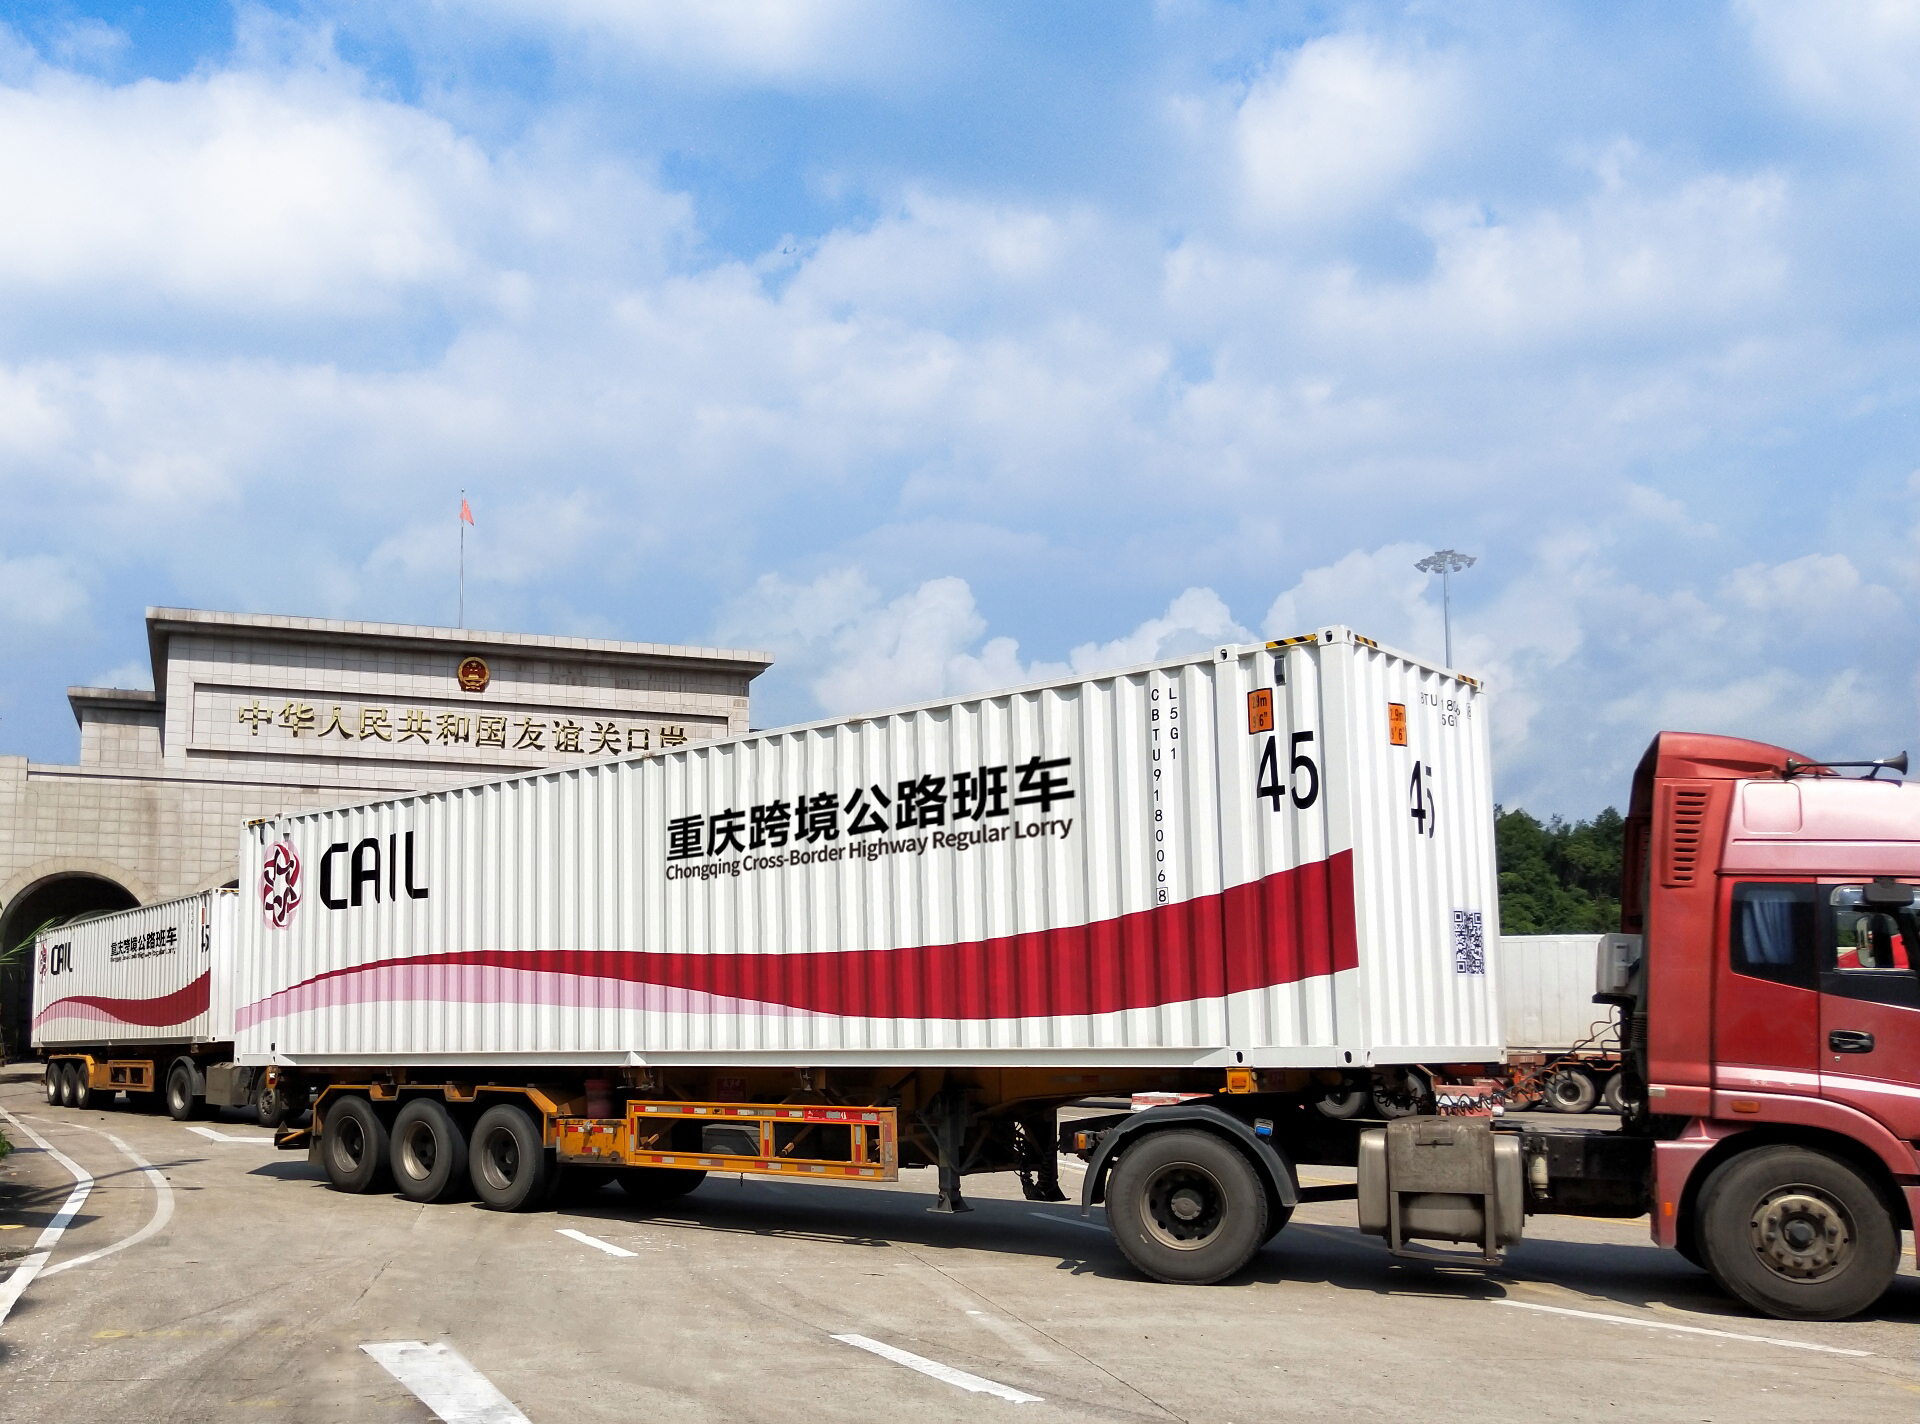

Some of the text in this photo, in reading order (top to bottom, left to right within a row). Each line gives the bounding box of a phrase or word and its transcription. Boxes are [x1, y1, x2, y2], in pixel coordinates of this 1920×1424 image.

[239, 700, 687, 756] 中华人民共和国友谊关口岸
[1169, 687, 1179, 760] L5G1
[1256, 730, 1319, 812] 45
[666, 755, 1075, 862] 重庆跨境公路班车
[319, 830, 429, 910] CAIL
[666, 818, 1074, 881] Chongqing Cross-Border Highway Regular Lorry
[50, 941, 74, 976] CAIL
